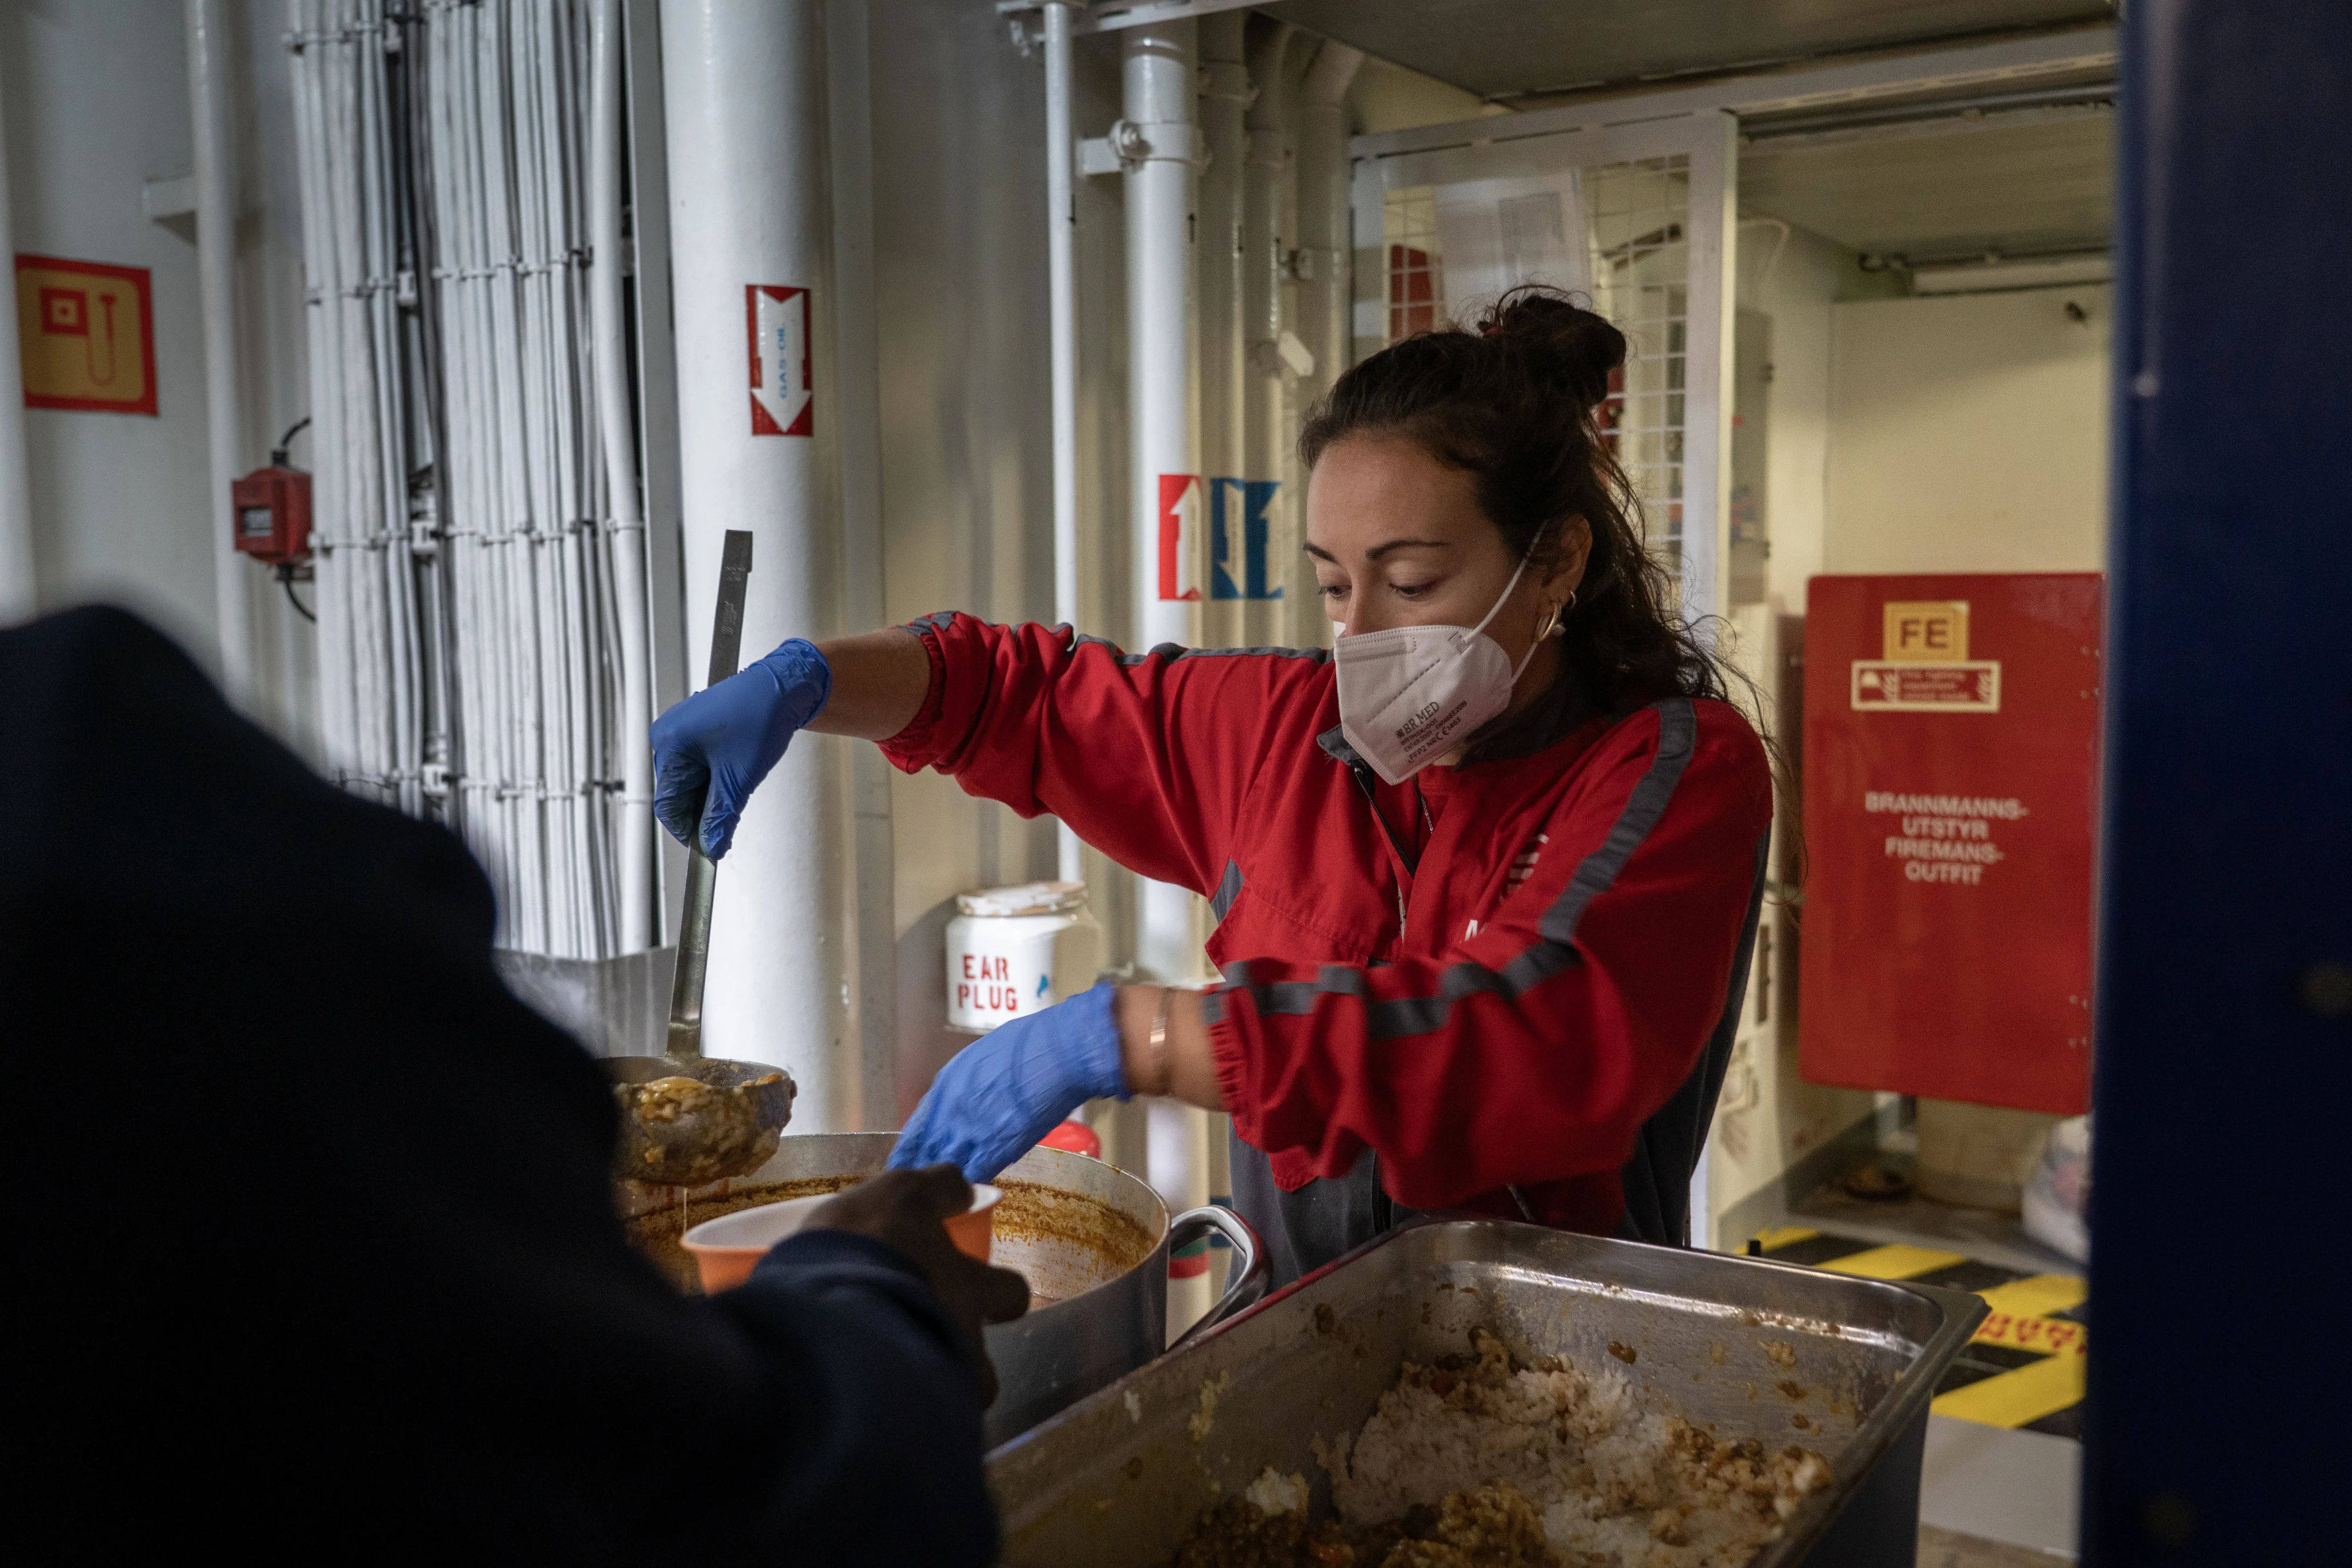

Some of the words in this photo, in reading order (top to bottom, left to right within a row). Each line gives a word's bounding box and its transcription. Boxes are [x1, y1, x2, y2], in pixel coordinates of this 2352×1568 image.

[779, 359, 788, 398] GAS
[1899, 617, 1949, 649] FE
[1402, 718, 1419, 734] BR
[1415, 702, 1439, 724] MED
[1409, 745, 1427, 760] FFP2
[1426, 737, 1437, 748] NR
[1902, 816, 1989, 840] UTSTYR
[1905, 861, 1982, 885] OUTFIT
[962, 954, 1009, 980] EAR
[957, 984, 1018, 1011] PLUG
